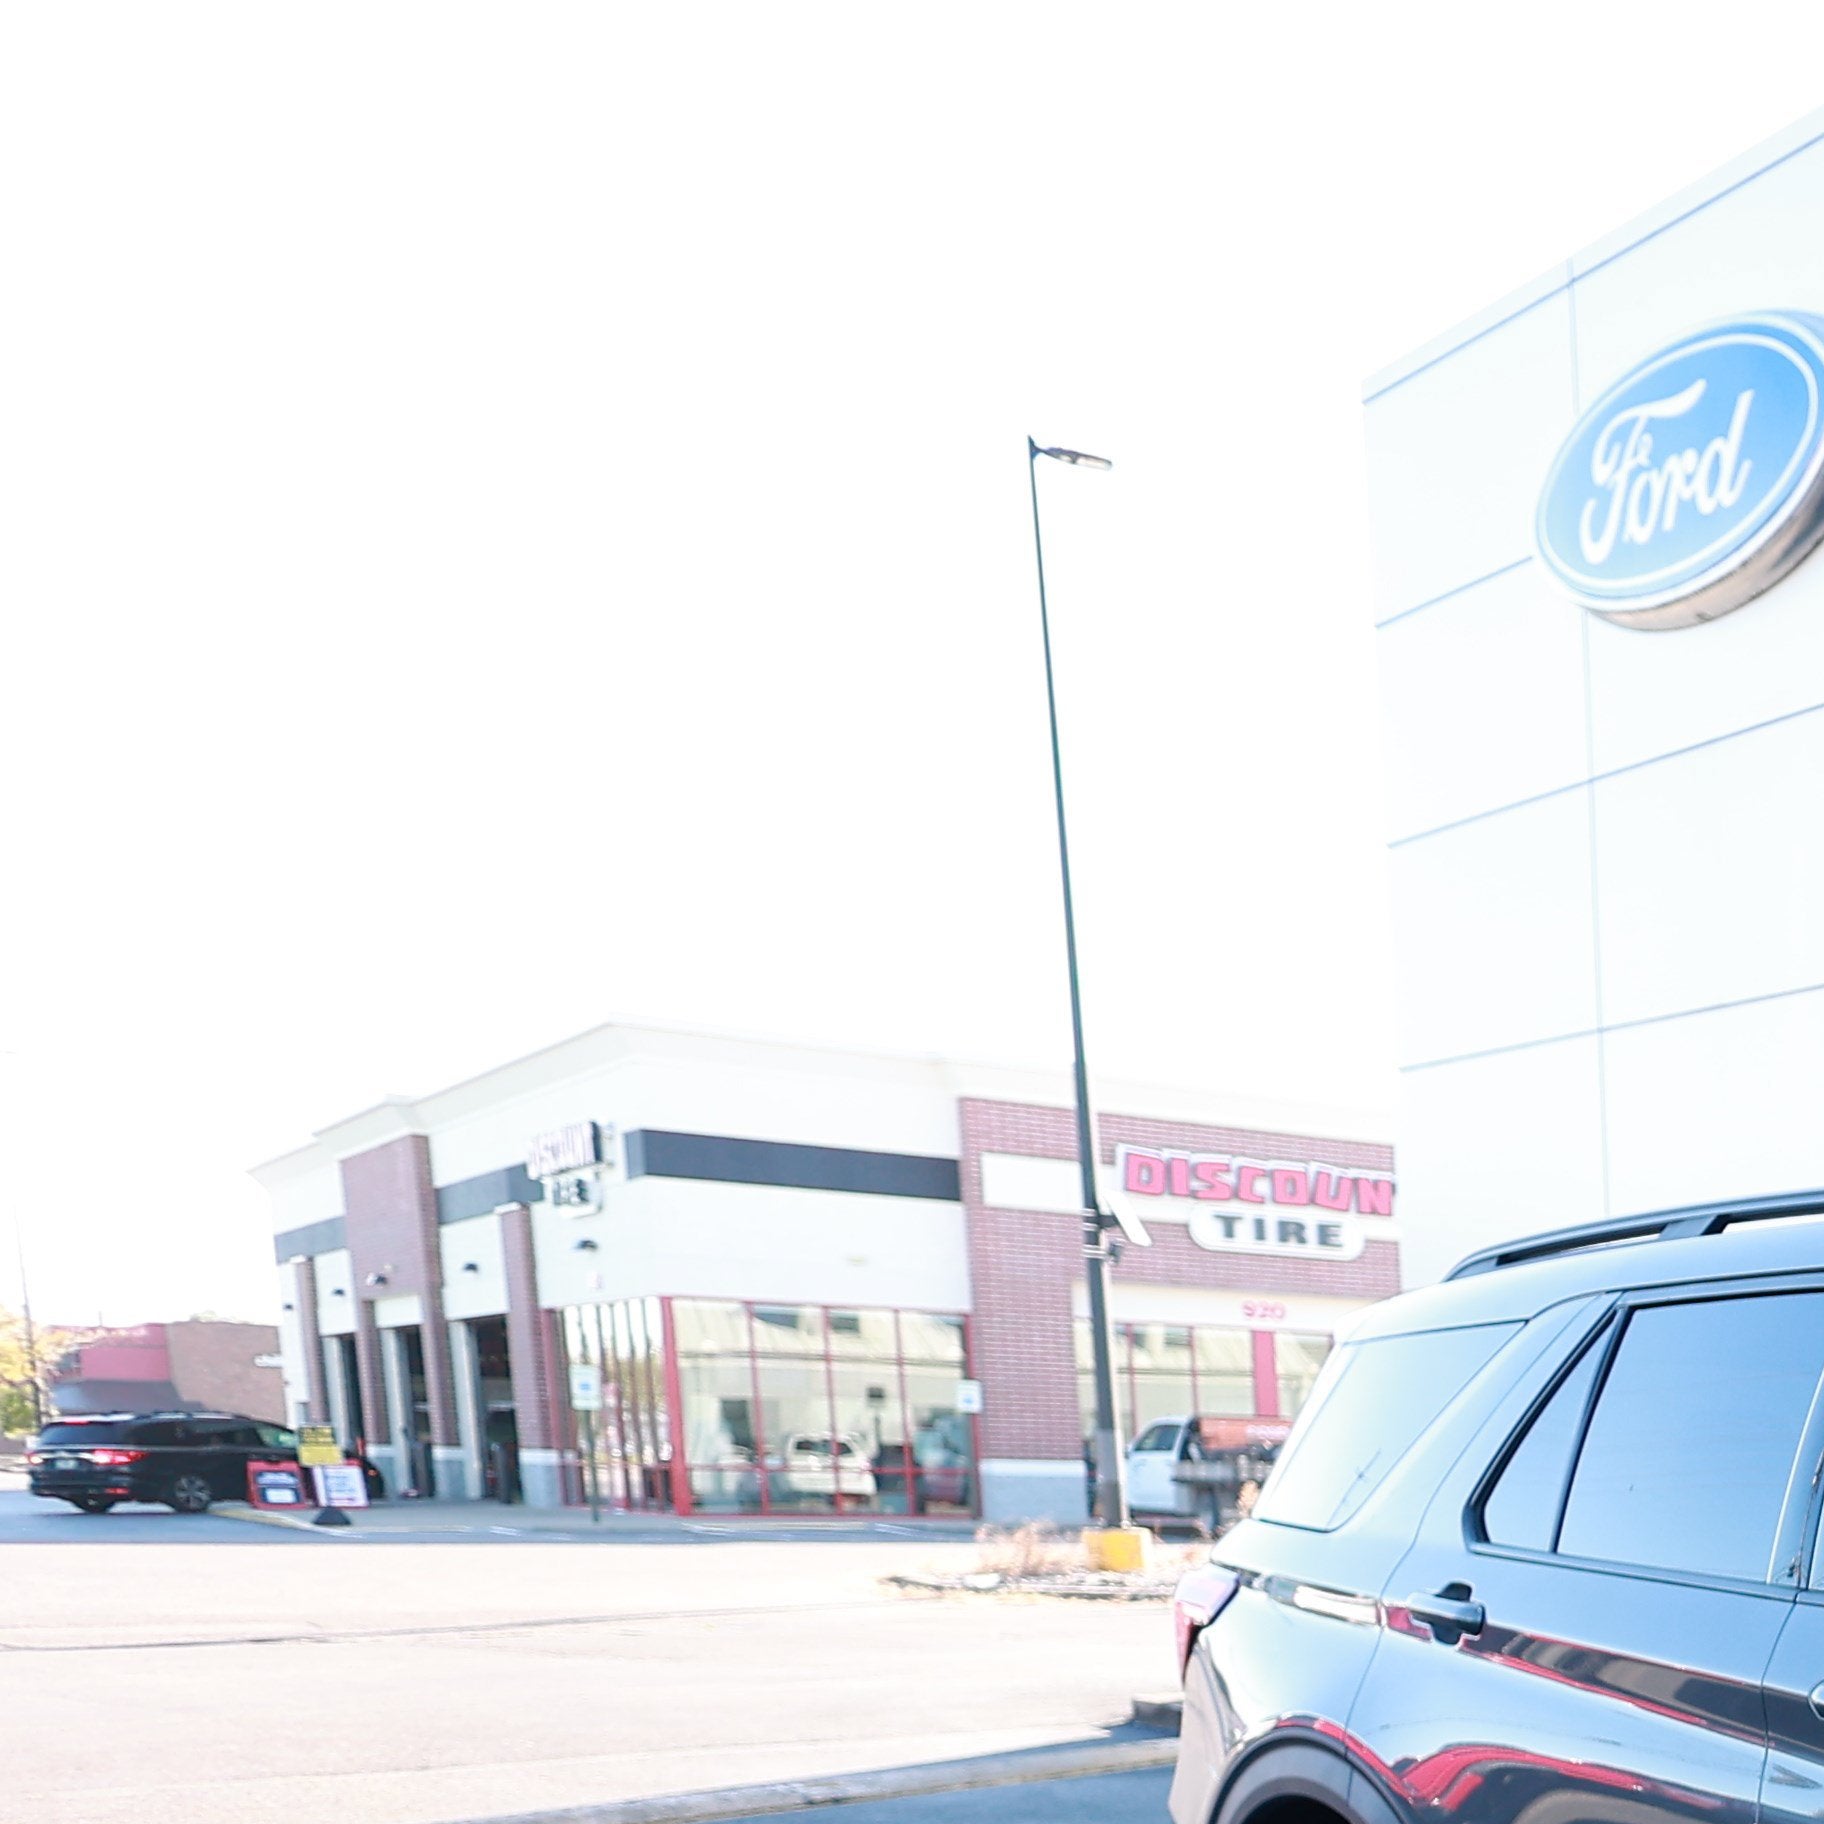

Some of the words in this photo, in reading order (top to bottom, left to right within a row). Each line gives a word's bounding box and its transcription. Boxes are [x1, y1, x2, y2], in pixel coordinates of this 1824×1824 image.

[1579, 377, 1755, 565] Ford
[1125, 1152, 1396, 1216] DISCOUN
[1213, 1213, 1343, 1247] TIRE
